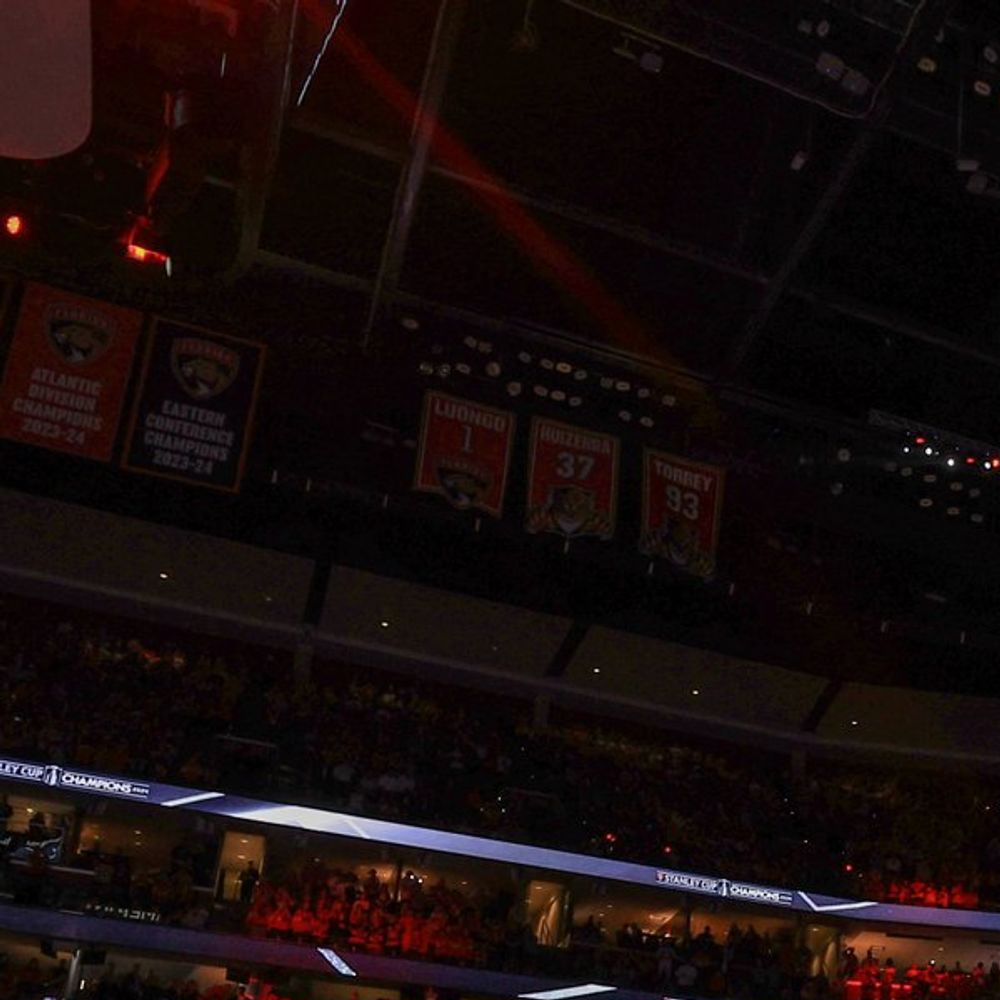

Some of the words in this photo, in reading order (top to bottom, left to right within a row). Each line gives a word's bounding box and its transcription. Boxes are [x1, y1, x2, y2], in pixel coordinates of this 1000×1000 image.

[31, 367, 103, 395] ATLANTIC
[28, 383, 97, 411] DIVISION
[12, 397, 103, 431] CHAMPIONS
[161, 399, 227, 426] EASTERN
[434, 400, 506, 433] LUONGO
[22, 417, 86, 446] 2023-24
[145, 412, 235, 447] CONFERENCE
[143, 430, 228, 462] CHAMPIONS
[153, 449, 213, 476] 2023-24
[556, 451, 595, 480] 37
[653, 460, 714, 492] TORREY
[665, 485, 699, 520] 93
[21, 764, 44, 778] CUP
[62, 773, 132, 794] CHAMPIONS
